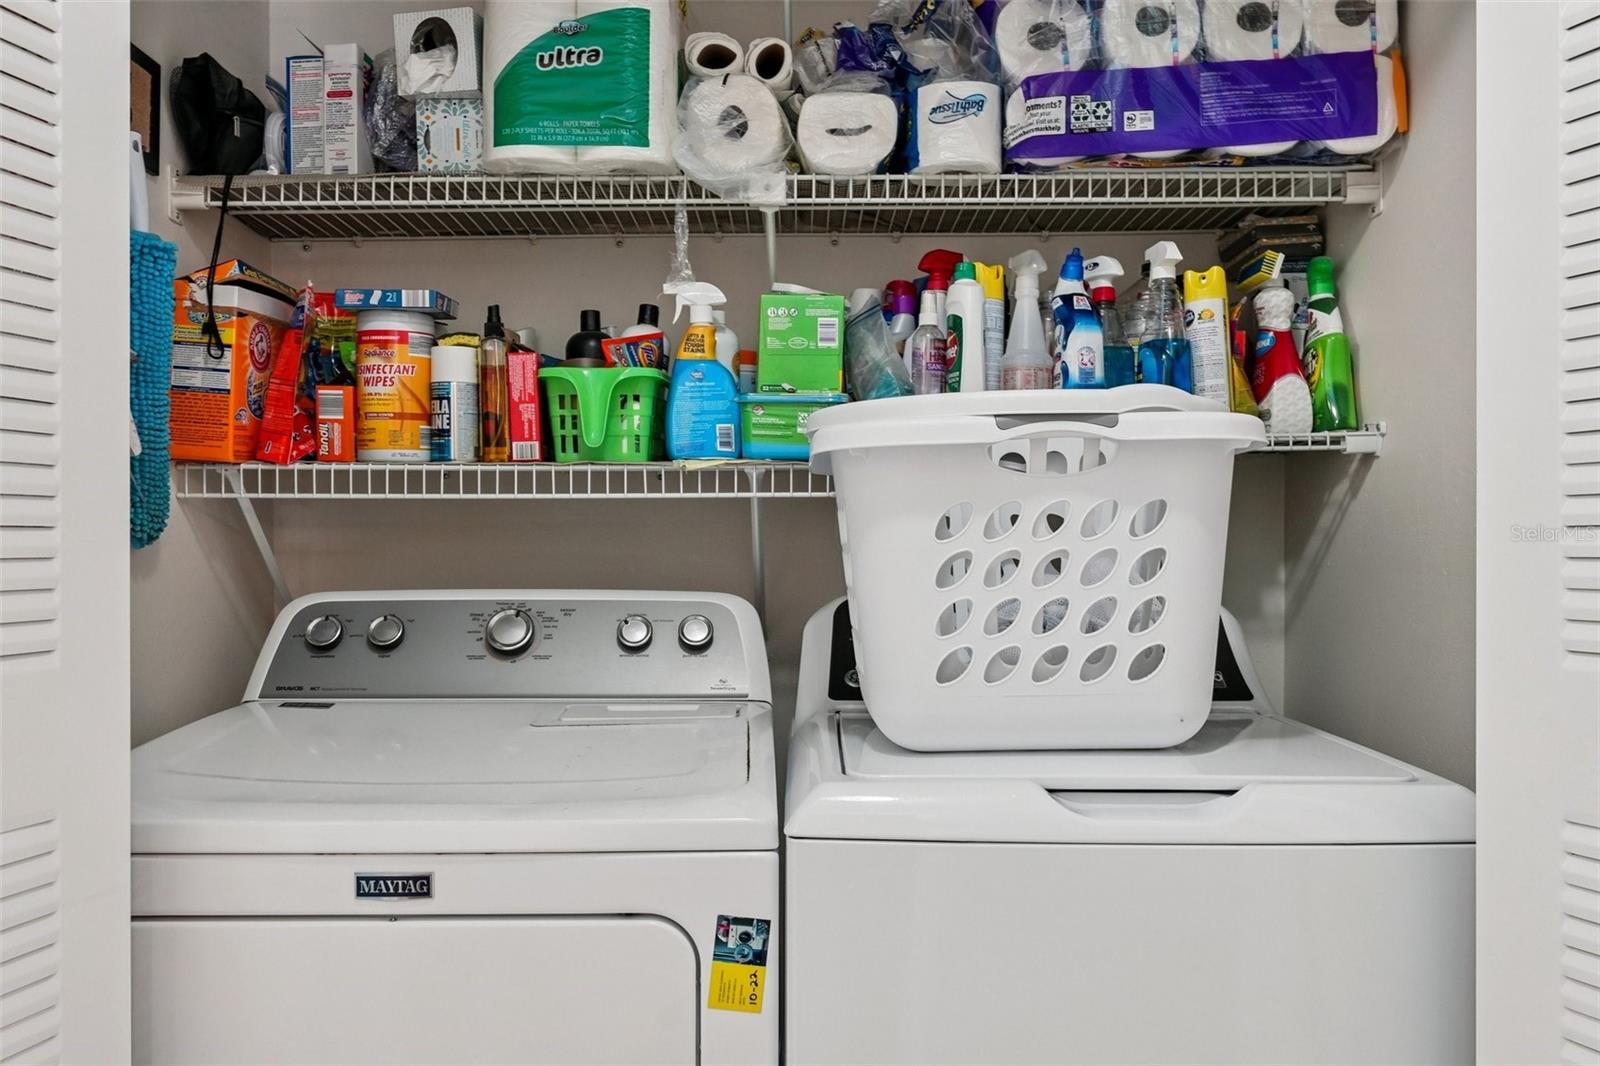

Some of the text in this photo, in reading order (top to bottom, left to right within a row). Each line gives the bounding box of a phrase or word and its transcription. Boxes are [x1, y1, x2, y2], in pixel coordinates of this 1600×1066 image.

[536, 45, 603, 71] ultra
[363, 376, 396, 388] WIPES
[318, 423, 329, 456] Tandil
[359, 880, 429, 894] MAYTAG
